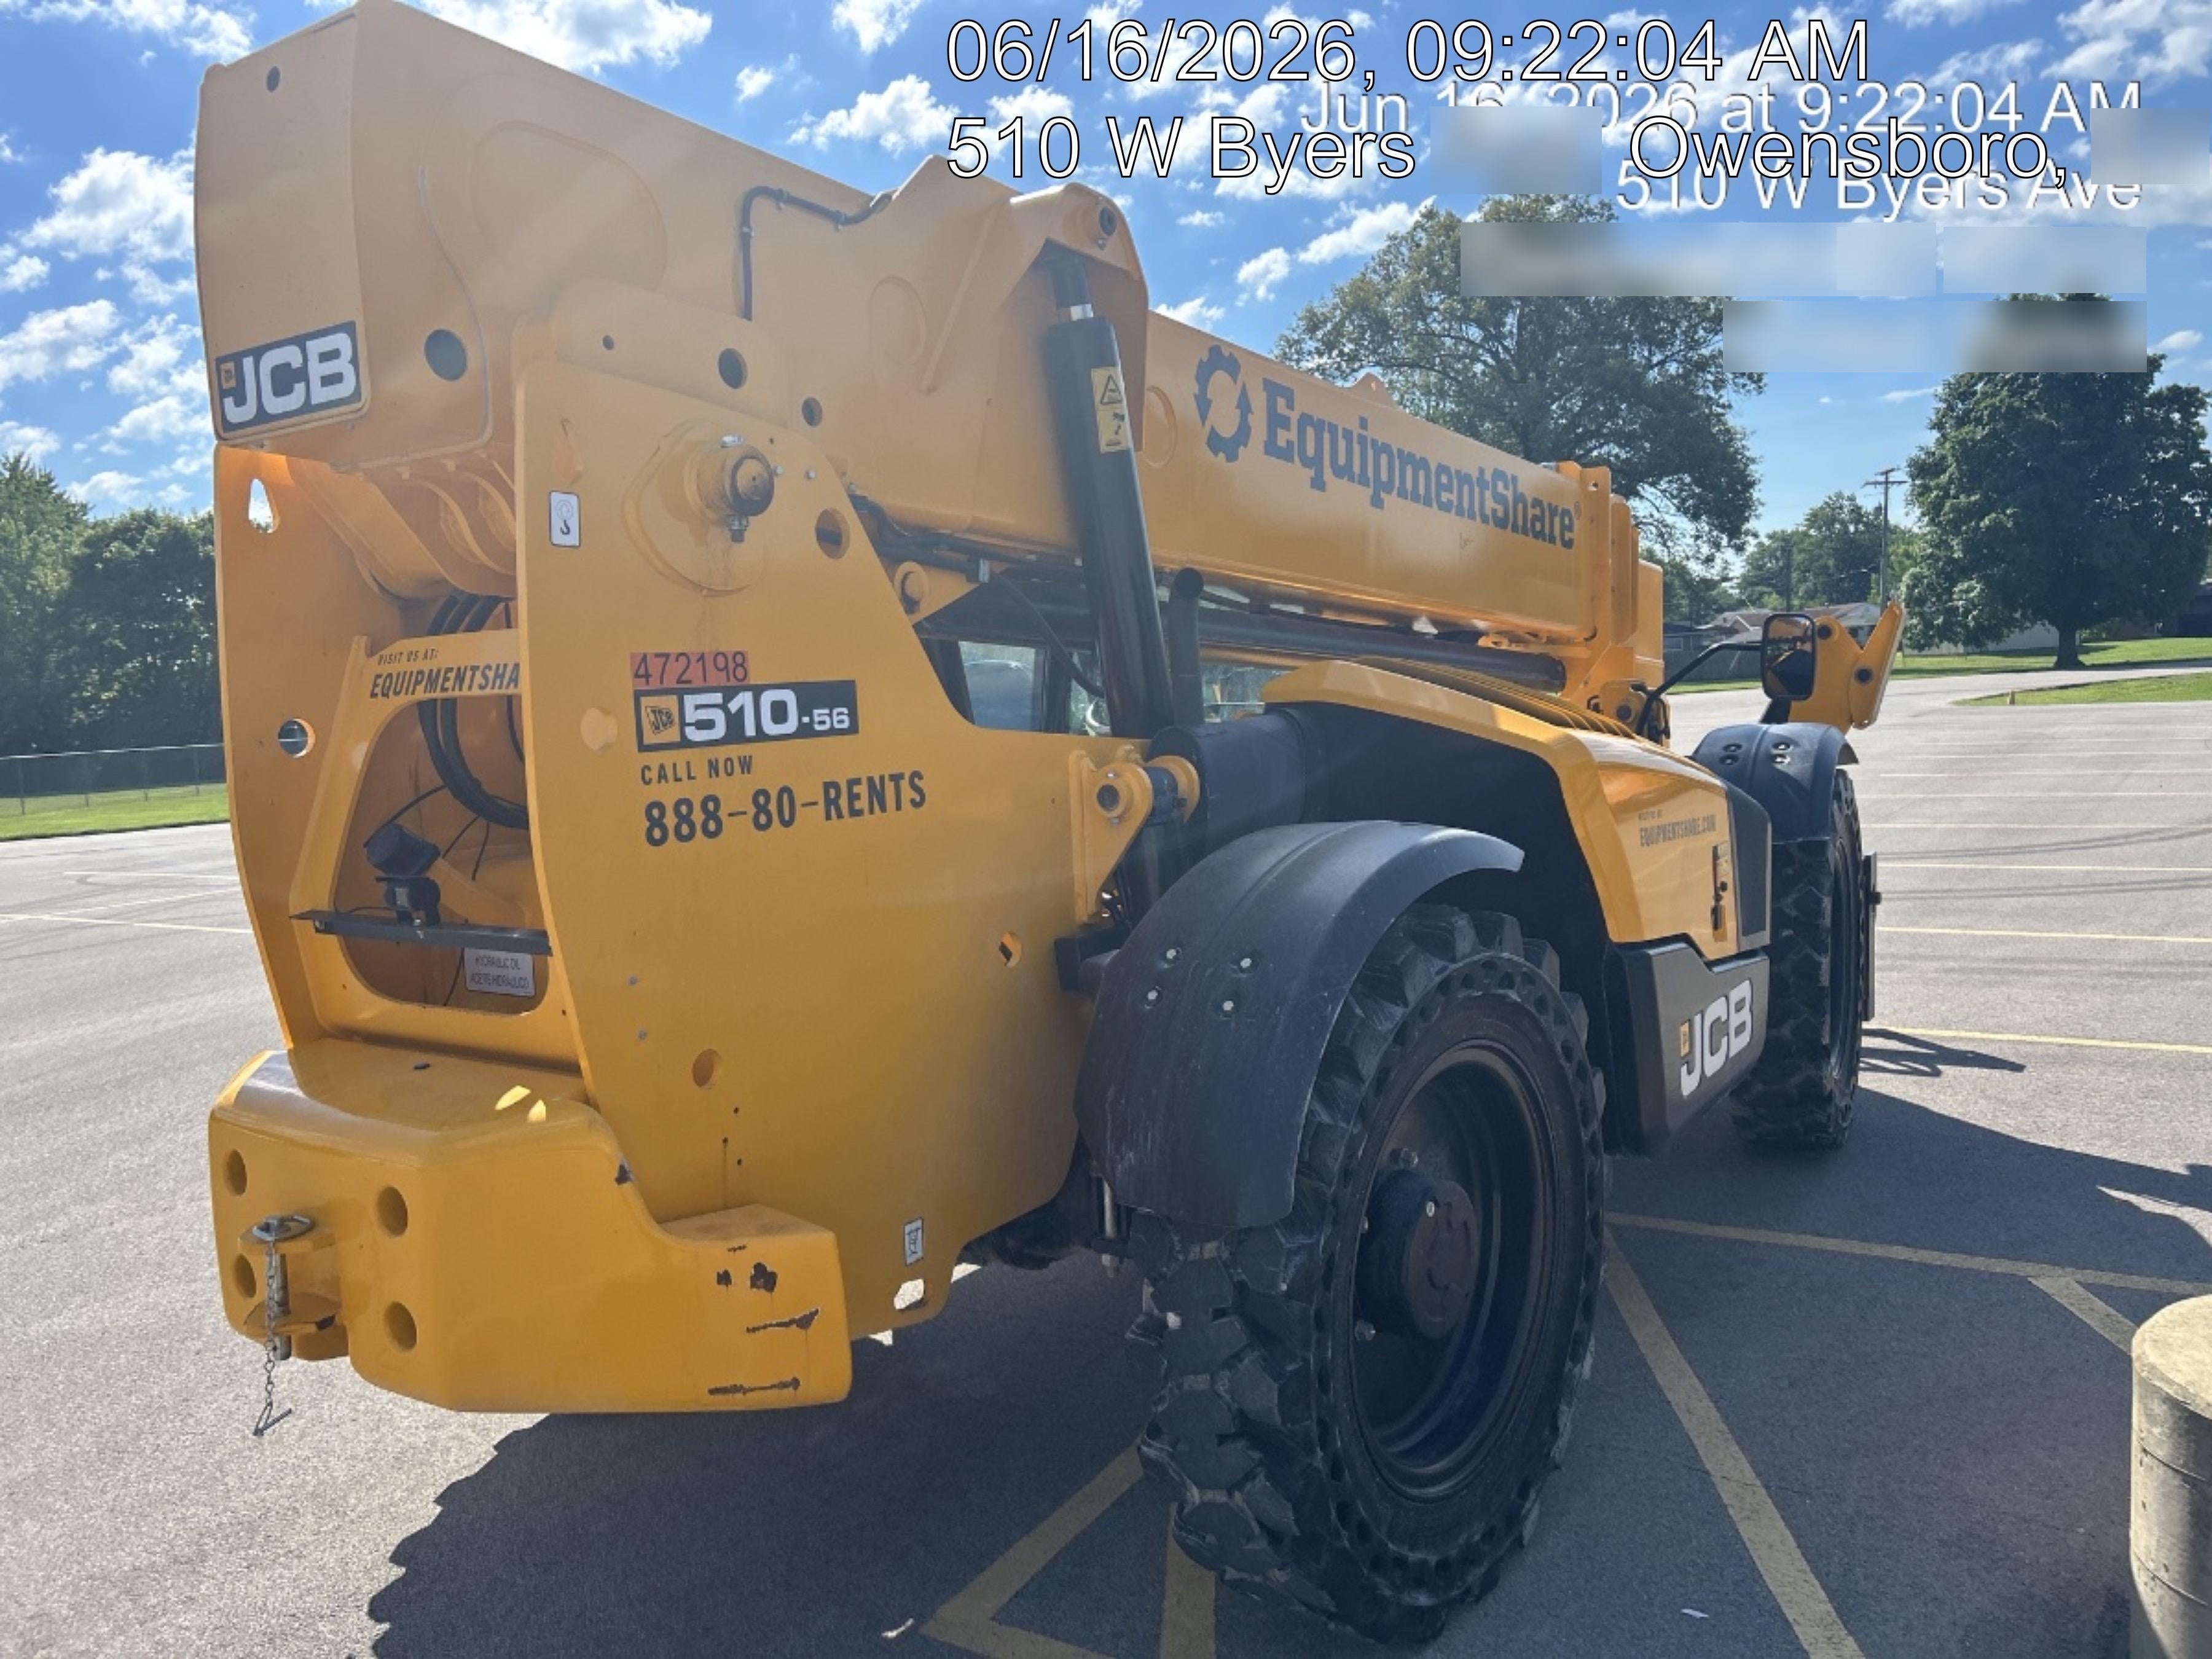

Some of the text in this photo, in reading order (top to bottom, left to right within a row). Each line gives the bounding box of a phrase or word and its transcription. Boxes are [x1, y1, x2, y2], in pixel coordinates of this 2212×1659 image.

[223, 332, 356, 424] JCB
[1261, 377, 1575, 550] EquipmentShare
[633, 651, 748, 685] 472198
[641, 755, 753, 785] CALL NOW
[644, 770, 927, 847] 888-80-RENTS
[1681, 979, 1753, 1097] JCB
